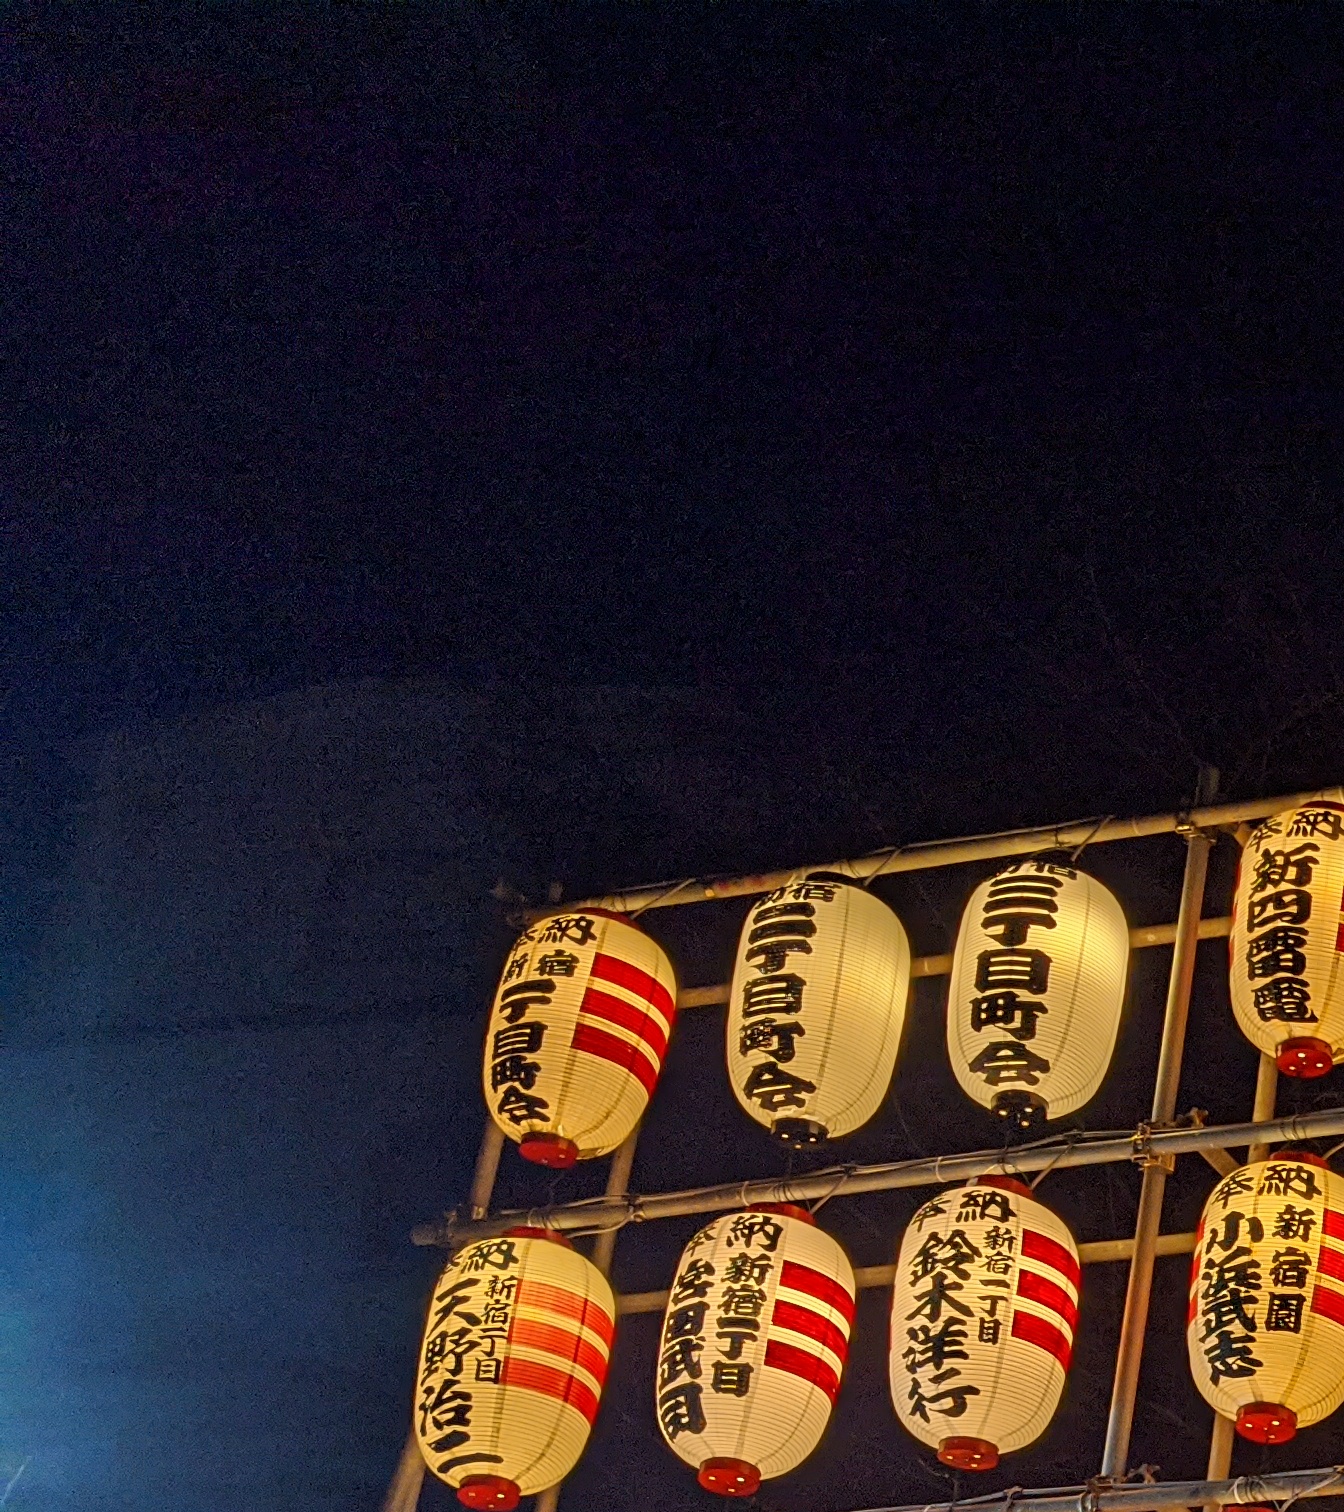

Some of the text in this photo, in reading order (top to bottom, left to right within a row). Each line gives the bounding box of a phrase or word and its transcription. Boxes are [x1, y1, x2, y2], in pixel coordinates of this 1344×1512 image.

[684, 1214, 785, 1258] 奉納
[910, 1188, 1017, 1233] 奉納
[1211, 1163, 1322, 1210] 奉納
[435, 1237, 519, 1285] 奉納
[975, 1224, 1018, 1348] 新宿一丁目
[1198, 1210, 1265, 1387] 小浜武志
[1262, 1202, 1318, 1337] 新宿園
[473, 1273, 519, 1388] 新宿一丁目
[710, 1251, 775, 1398] 新宿一丁目
[901, 1229, 982, 1425] 鈴木洋行
